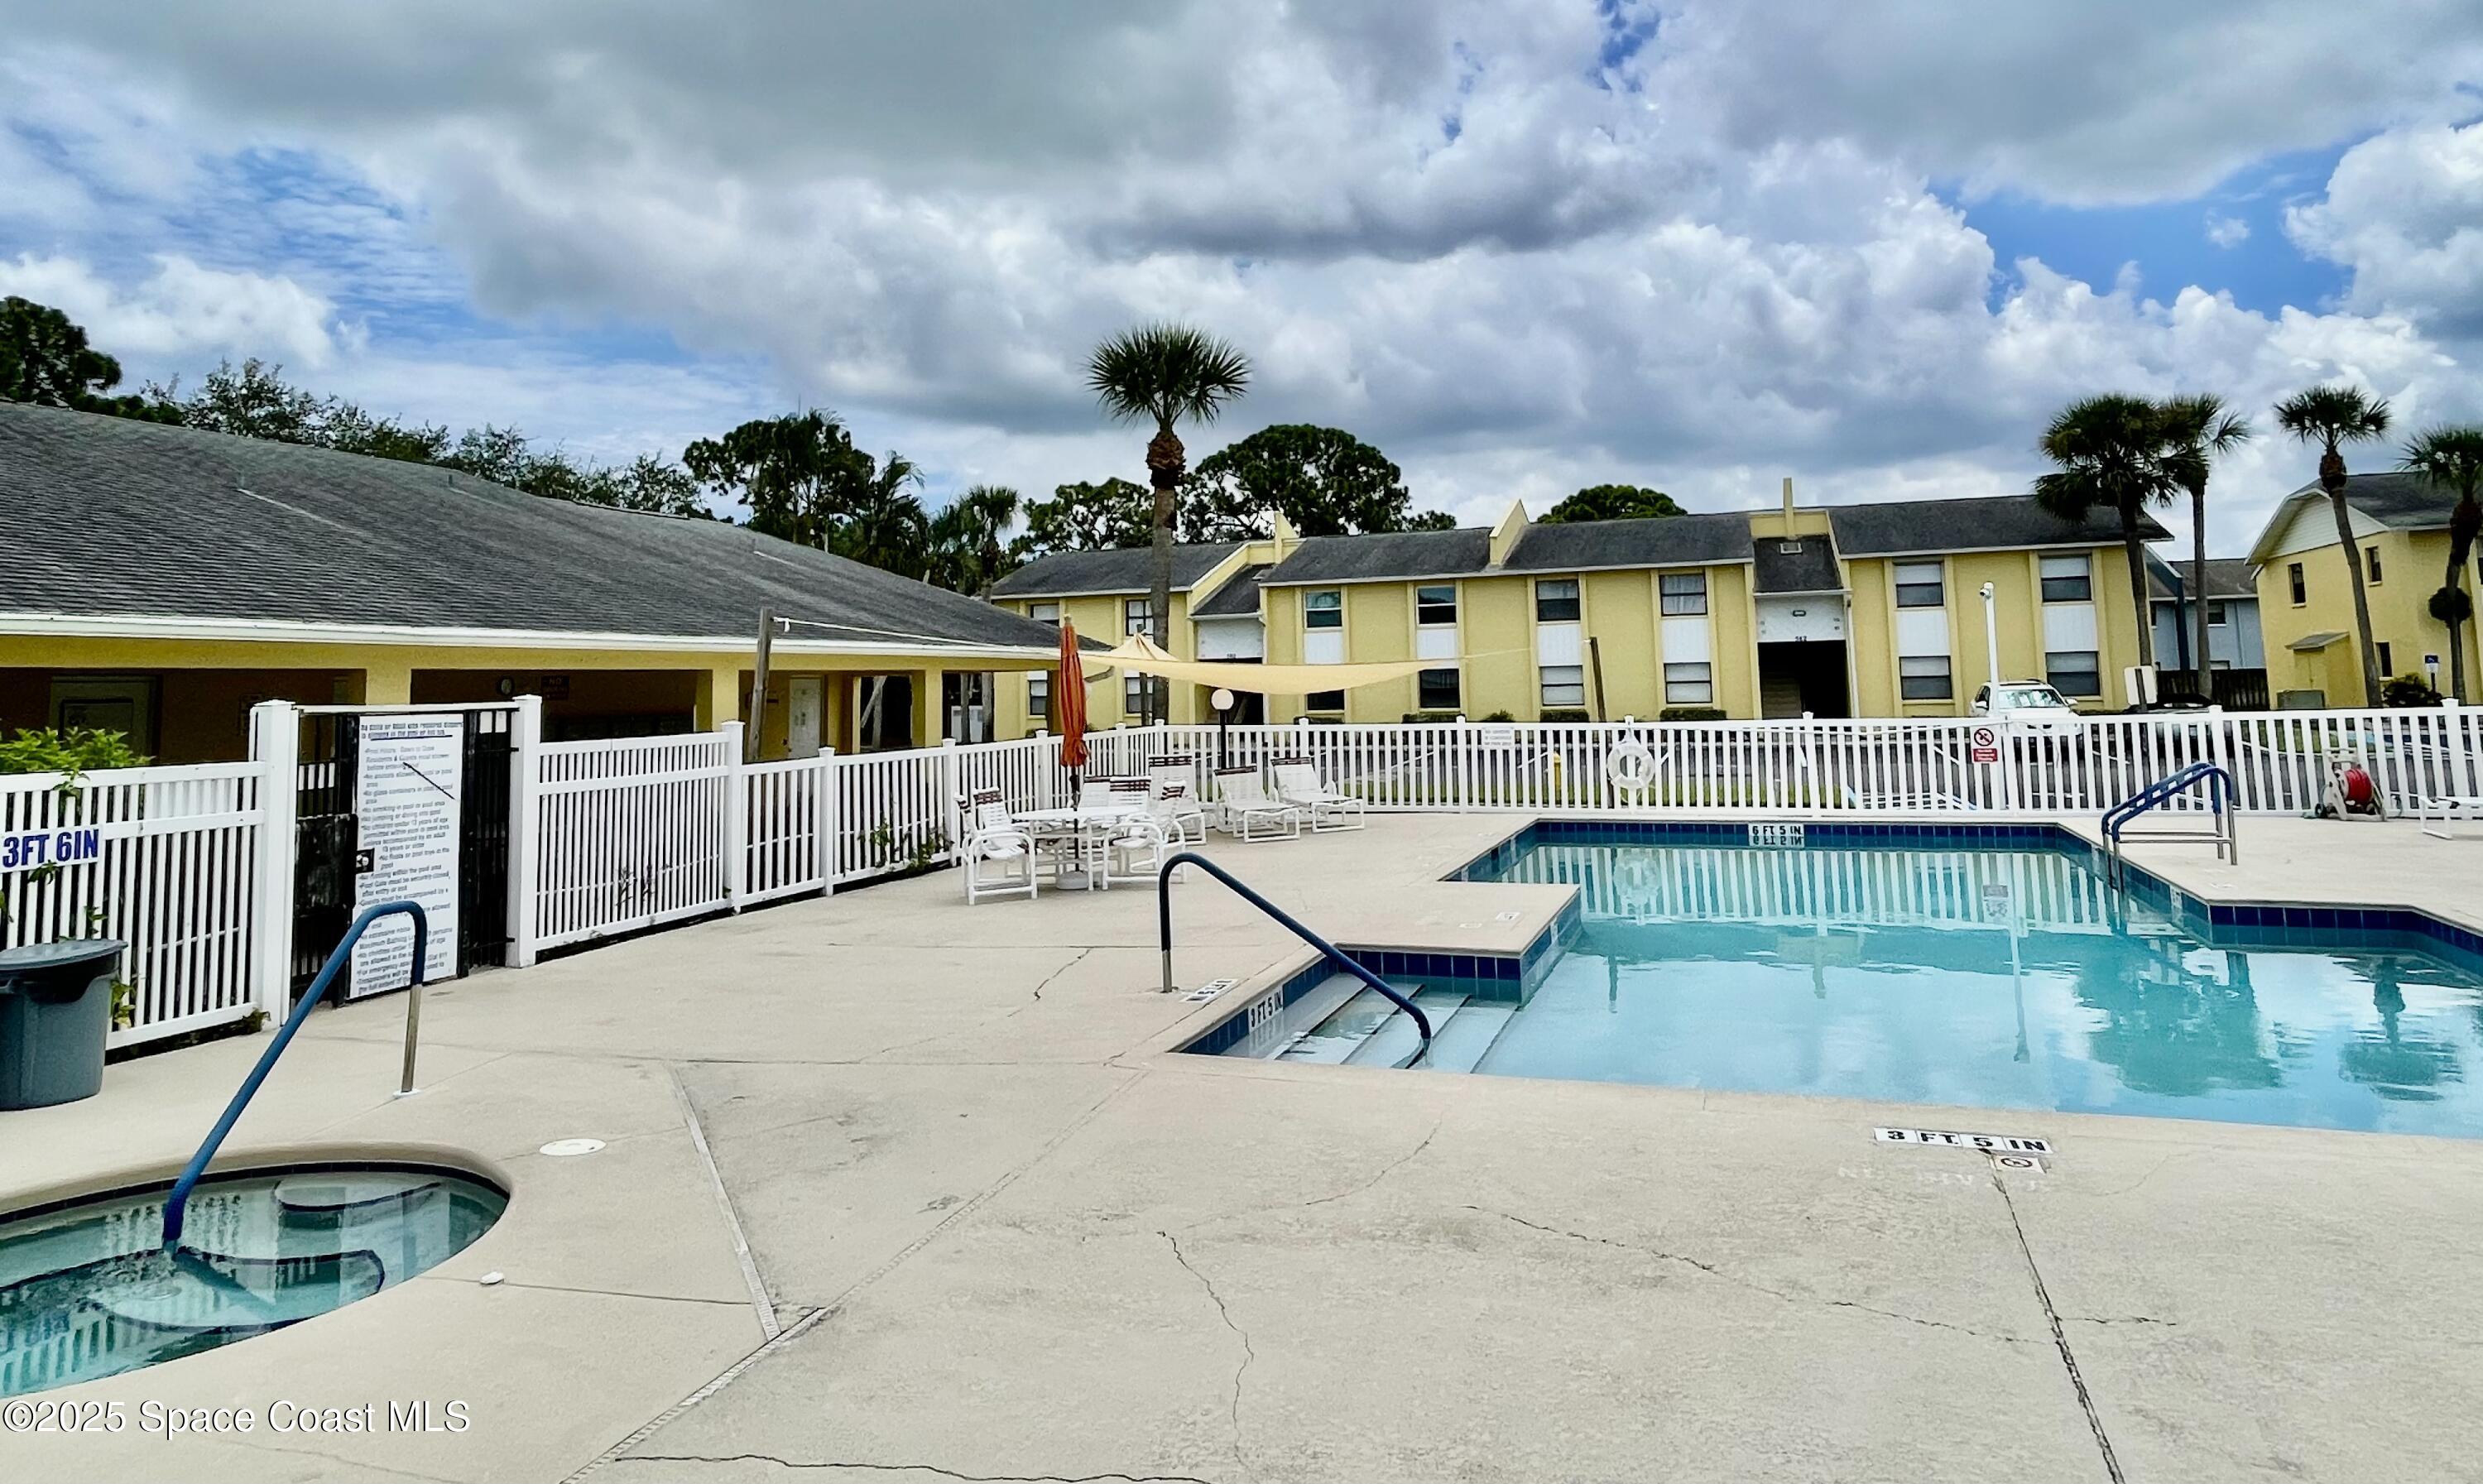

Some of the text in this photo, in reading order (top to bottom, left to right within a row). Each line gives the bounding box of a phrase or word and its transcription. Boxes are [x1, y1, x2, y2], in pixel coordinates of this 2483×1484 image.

[1752, 826, 1759, 834] 6
[1763, 826, 1775, 834] FT
[1779, 826, 1786, 834] 5
[2, 828, 99, 867] 3FT 6IN
[1251, 990, 1281, 1027] 3 FT 5 IN
[1887, 1131, 1905, 1140] 3
[1973, 1137, 1994, 1147] 5
[2009, 1140, 2046, 1150] IN
